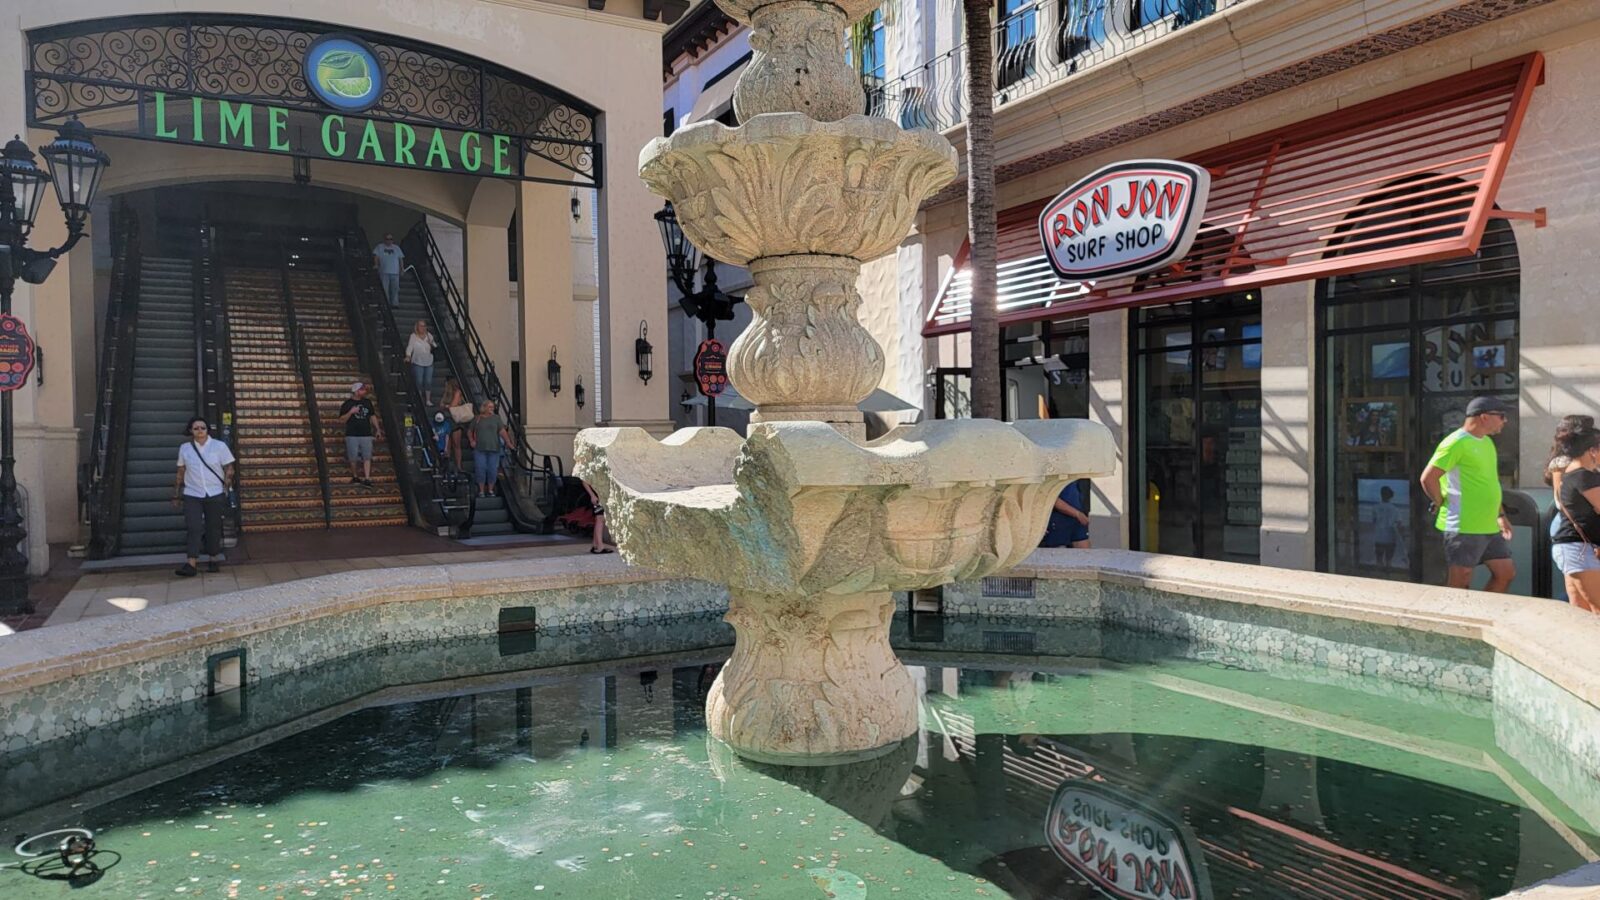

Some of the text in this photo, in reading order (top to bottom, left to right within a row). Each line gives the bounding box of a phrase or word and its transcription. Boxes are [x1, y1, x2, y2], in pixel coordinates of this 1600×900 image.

[154, 91, 512, 176] LIME GARAGE
[1053, 178, 1185, 249] RON JON
[1067, 223, 1163, 263] SURF SHOP
